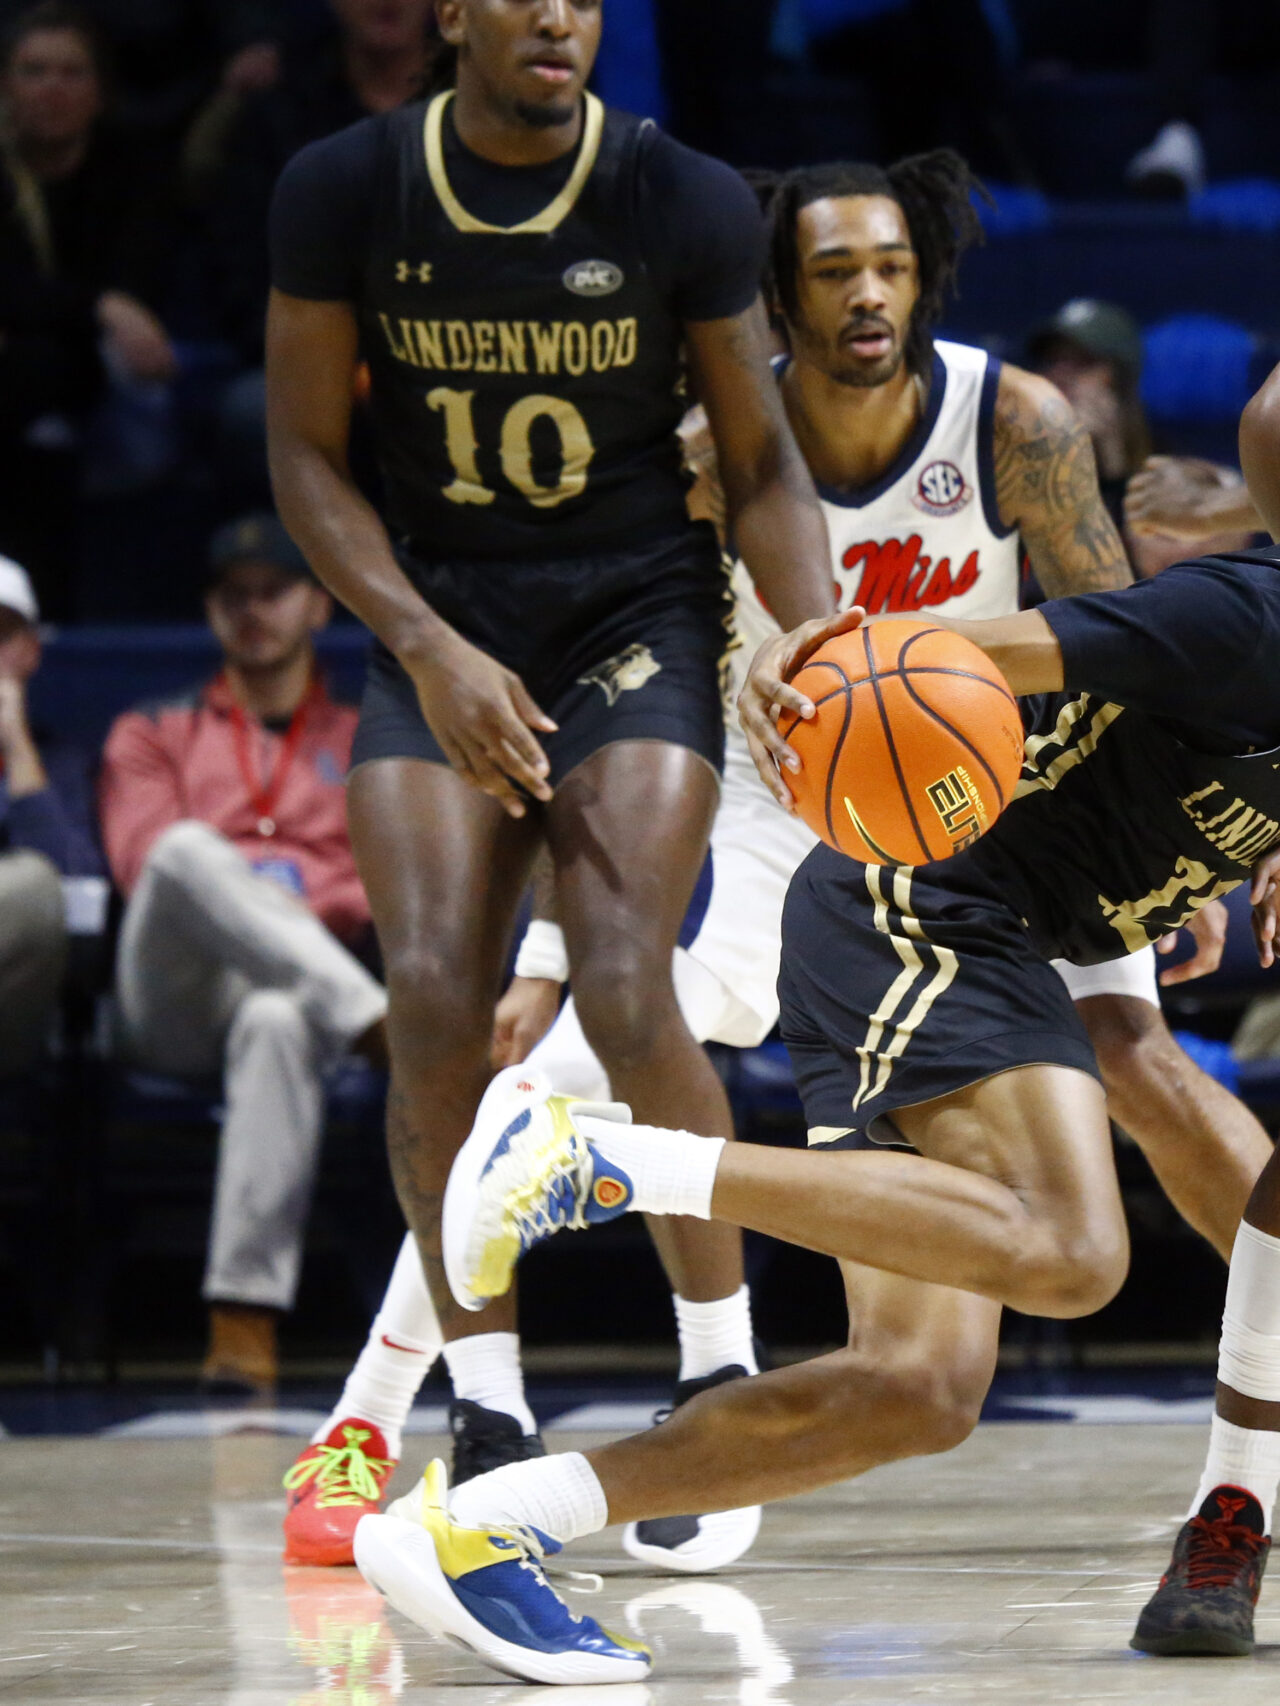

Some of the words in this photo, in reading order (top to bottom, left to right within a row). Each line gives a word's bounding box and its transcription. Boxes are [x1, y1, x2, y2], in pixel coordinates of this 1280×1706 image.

[378, 312, 638, 377] LINDENWOOD
[425, 386, 597, 509] 10
[921, 463, 962, 504] SEC
[842, 533, 982, 615] Miss
